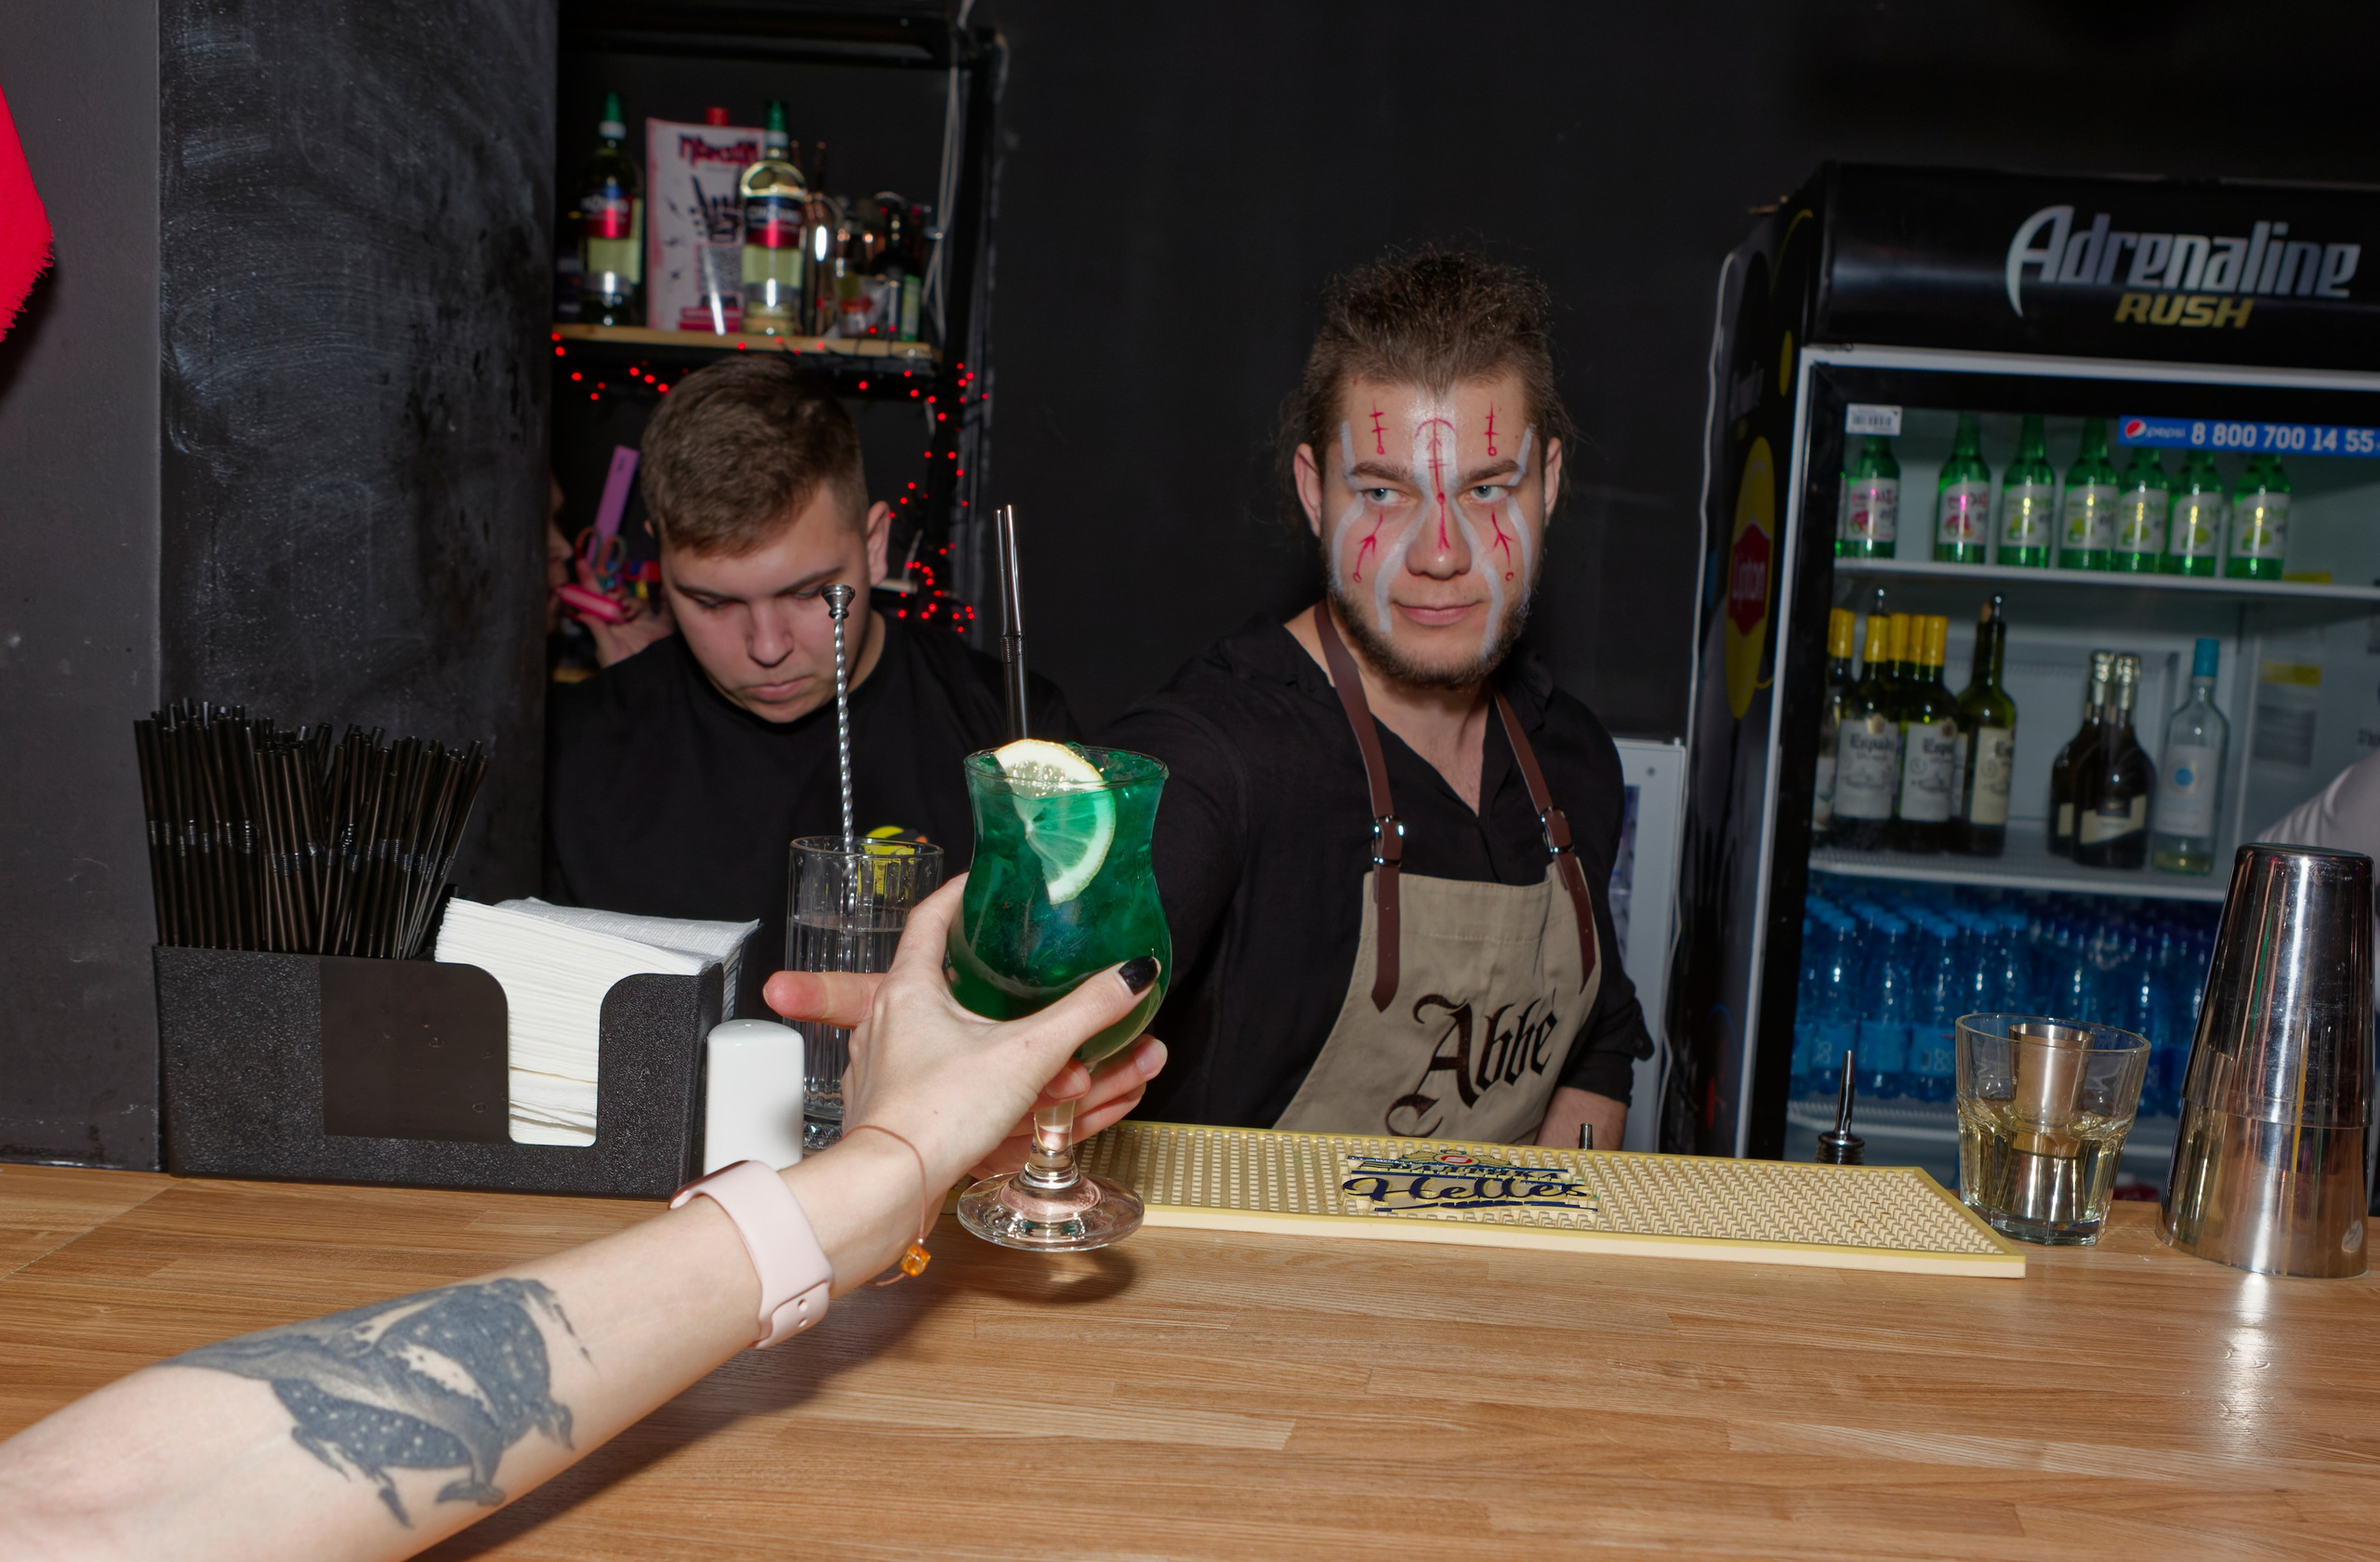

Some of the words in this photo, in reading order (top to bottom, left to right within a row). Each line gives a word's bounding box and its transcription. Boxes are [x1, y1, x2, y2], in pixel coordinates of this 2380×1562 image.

[2004, 205, 2361, 318] Adrenaline
[2113, 292, 2255, 329] RUSH
[2146, 426, 2186, 440] pepsi
[2191, 421, 2206, 445] 8
[2212, 423, 2257, 448] 800
[2263, 425, 2307, 451] 700
[2311, 427, 2338, 452] 14
[2345, 429, 2375, 454] 55
[1342, 1176, 1593, 1202] Helles
